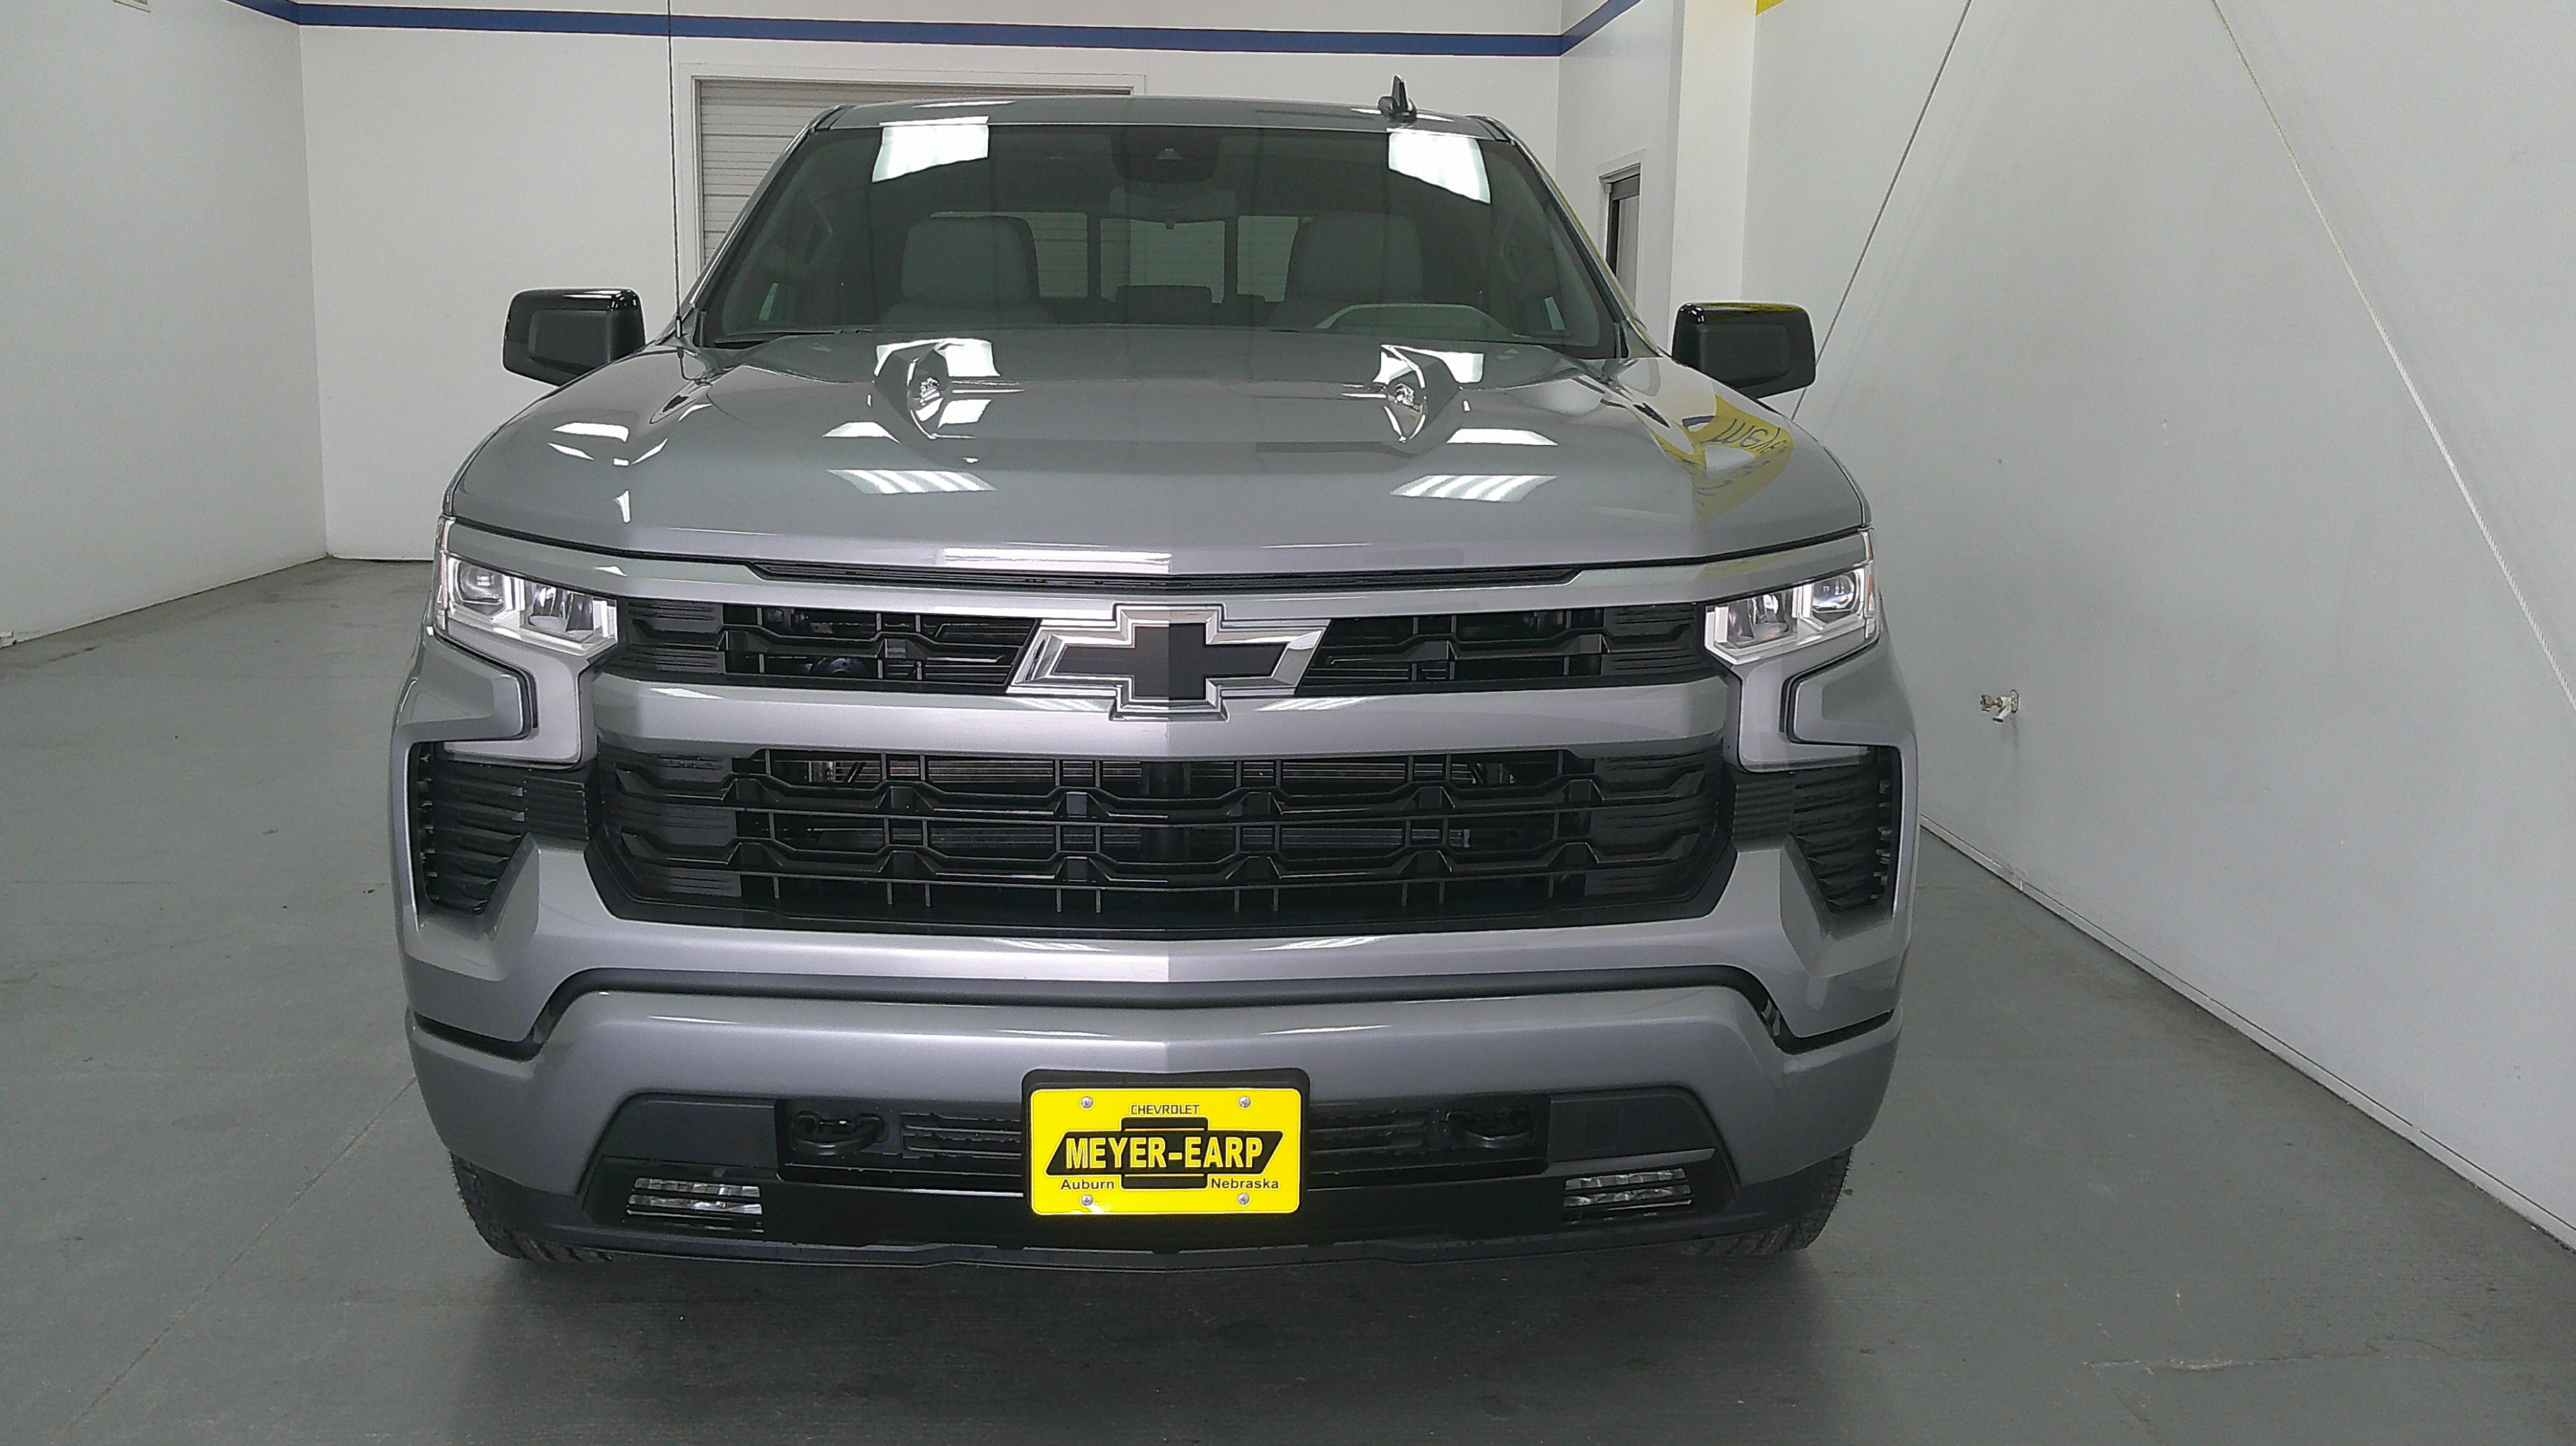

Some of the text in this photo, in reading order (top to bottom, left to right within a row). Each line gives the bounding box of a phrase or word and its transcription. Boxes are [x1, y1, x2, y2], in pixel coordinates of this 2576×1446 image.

[1130, 1104, 1200, 1116] CHEVROLET
[1066, 1136, 1263, 1169] MEYER-EARP
[1060, 1177, 1280, 1190] Auburn Nebraska
